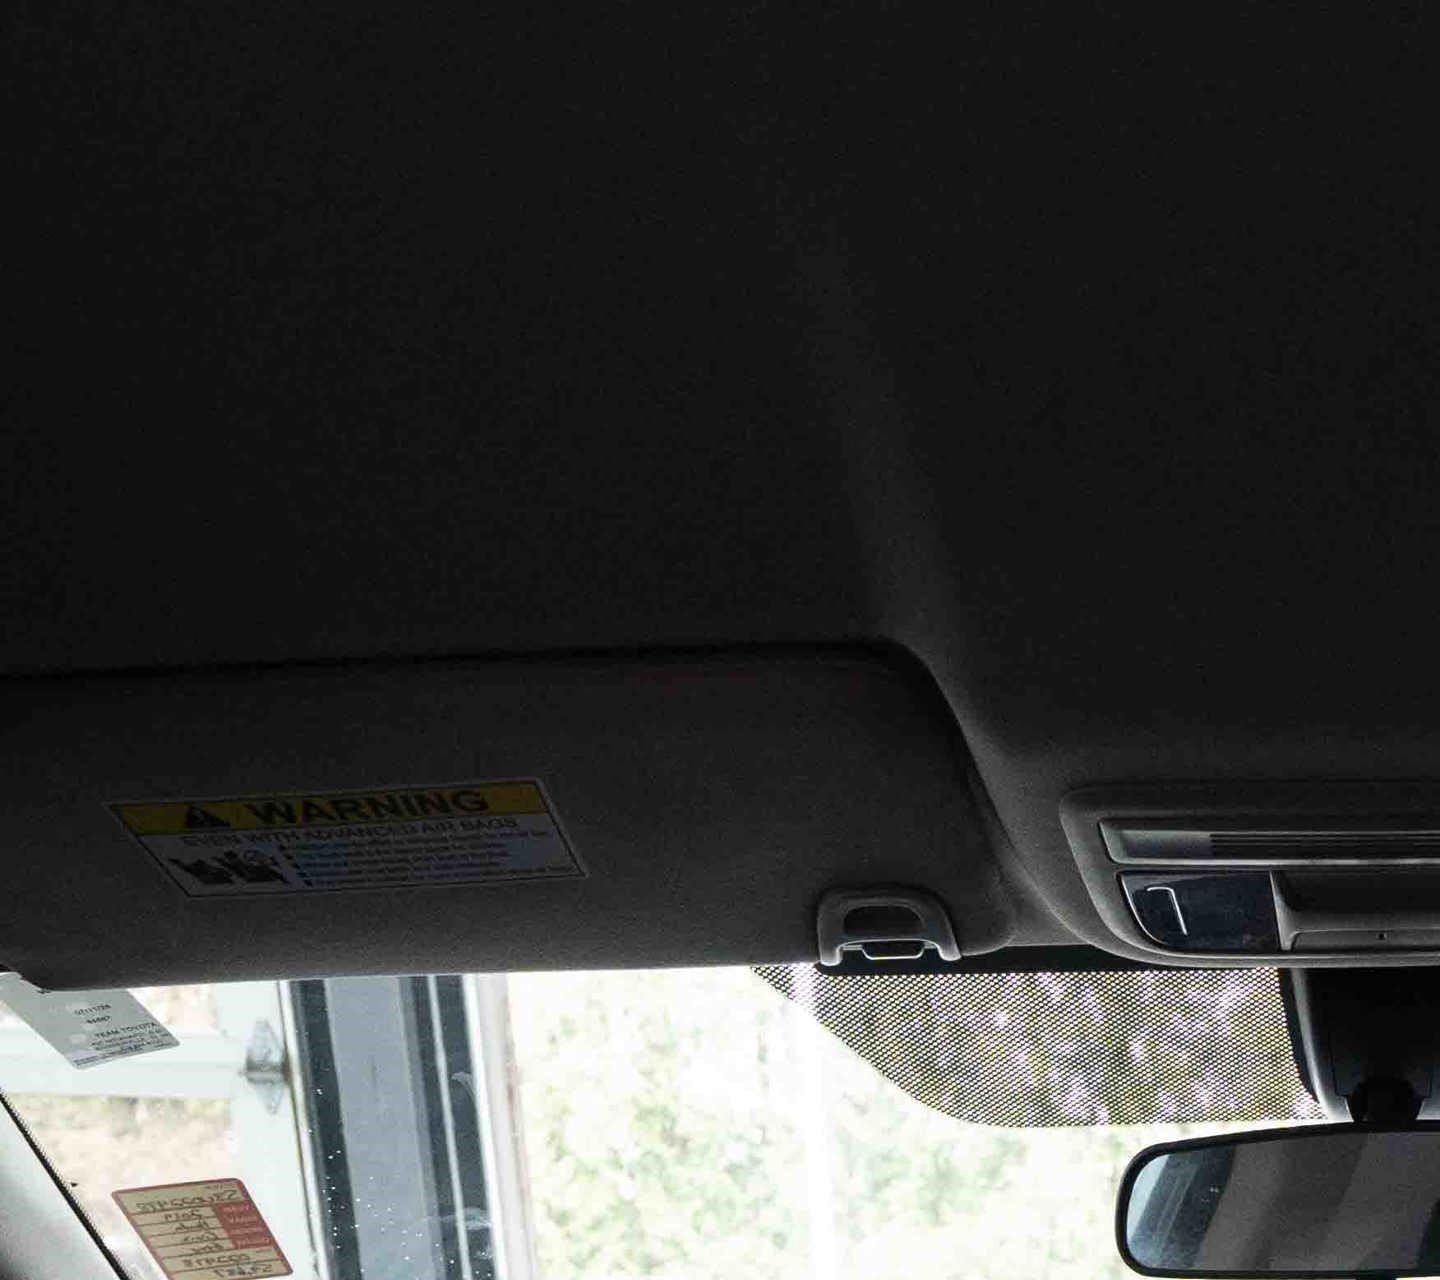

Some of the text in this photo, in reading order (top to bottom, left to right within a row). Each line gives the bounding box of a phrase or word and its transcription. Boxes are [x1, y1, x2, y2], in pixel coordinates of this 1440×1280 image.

[247, 788, 490, 826] WARNING
[460, 816, 519, 832] BAGS
[94, 1028, 120, 1038] TEAM
